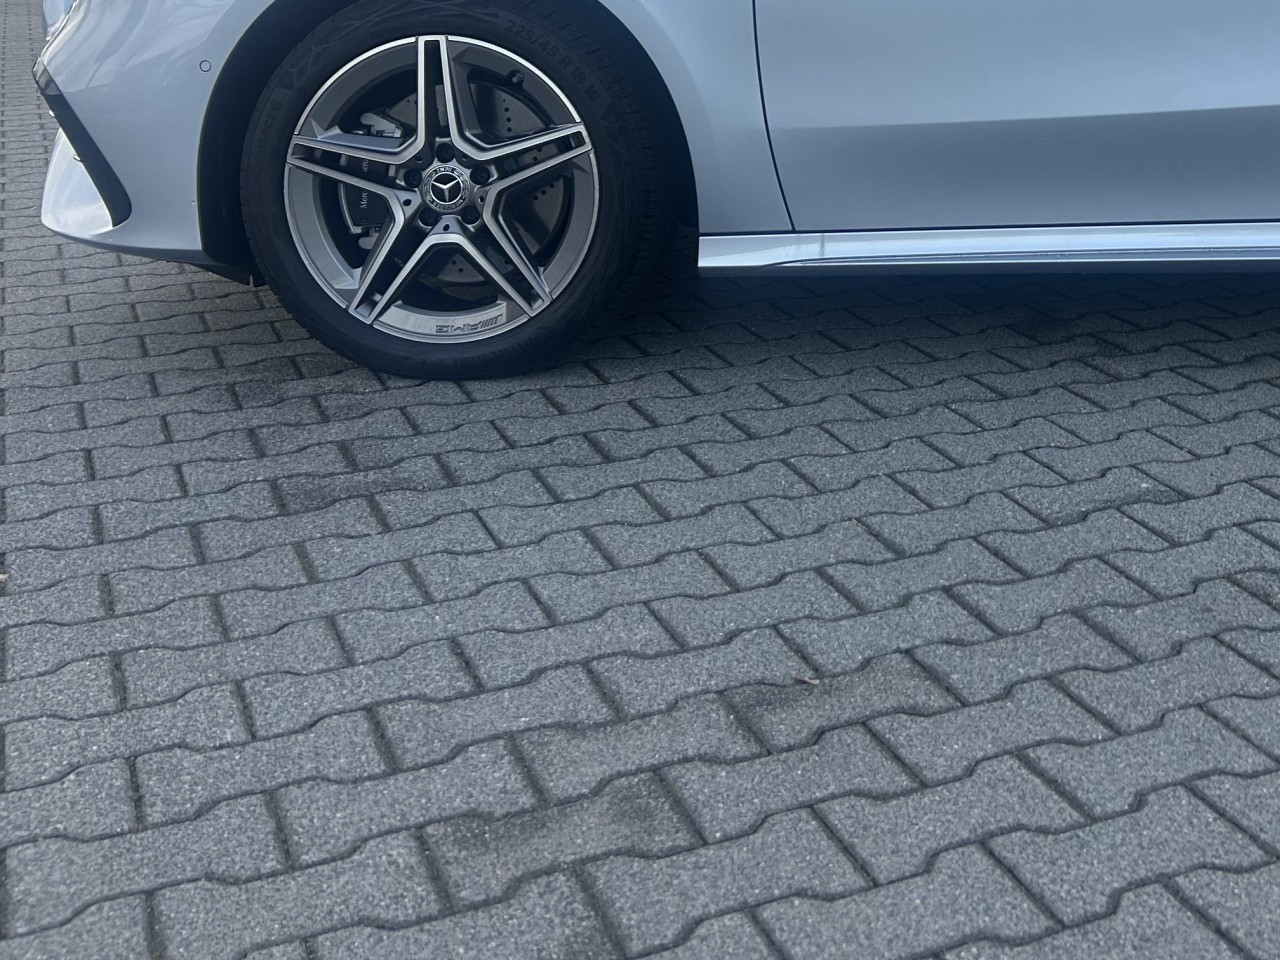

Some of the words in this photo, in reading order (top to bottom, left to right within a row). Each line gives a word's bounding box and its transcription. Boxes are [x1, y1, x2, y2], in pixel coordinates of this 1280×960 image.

[505, 19, 560, 59] 225/45
[558, 55, 573, 71] R
[569, 65, 587, 85] 18
[583, 83, 602, 102] W
[435, 319, 487, 334] AMG
